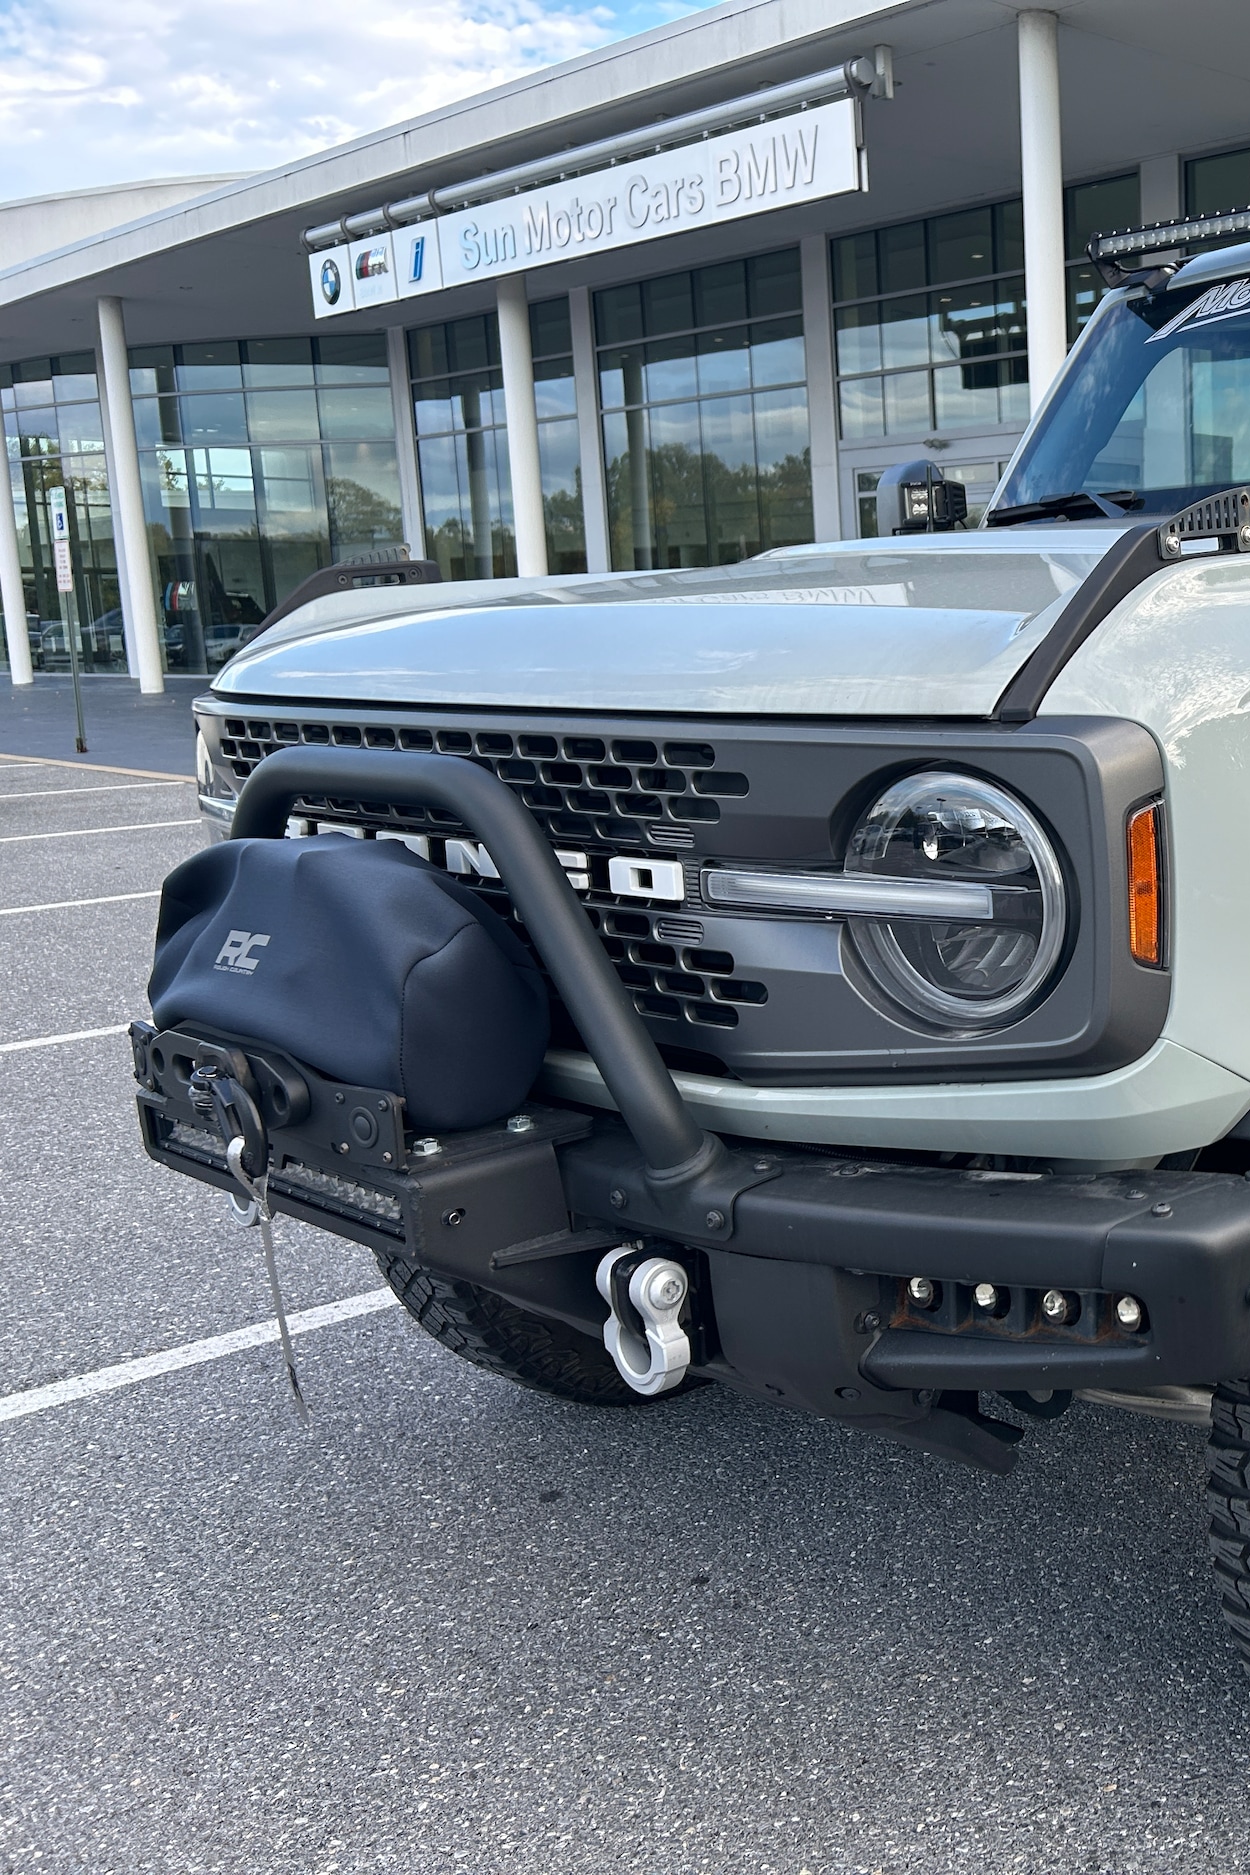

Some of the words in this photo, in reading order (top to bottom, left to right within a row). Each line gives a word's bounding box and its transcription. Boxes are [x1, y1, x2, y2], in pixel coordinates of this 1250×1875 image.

[459, 220, 516, 269] Sun
[521, 195, 618, 255] Motor
[624, 173, 704, 228] Cars
[714, 124, 819, 207] BMW
[213, 964, 229, 972] ROUGH
[229, 966, 254, 976] COUNTRY
[215, 930, 271, 970] RC
